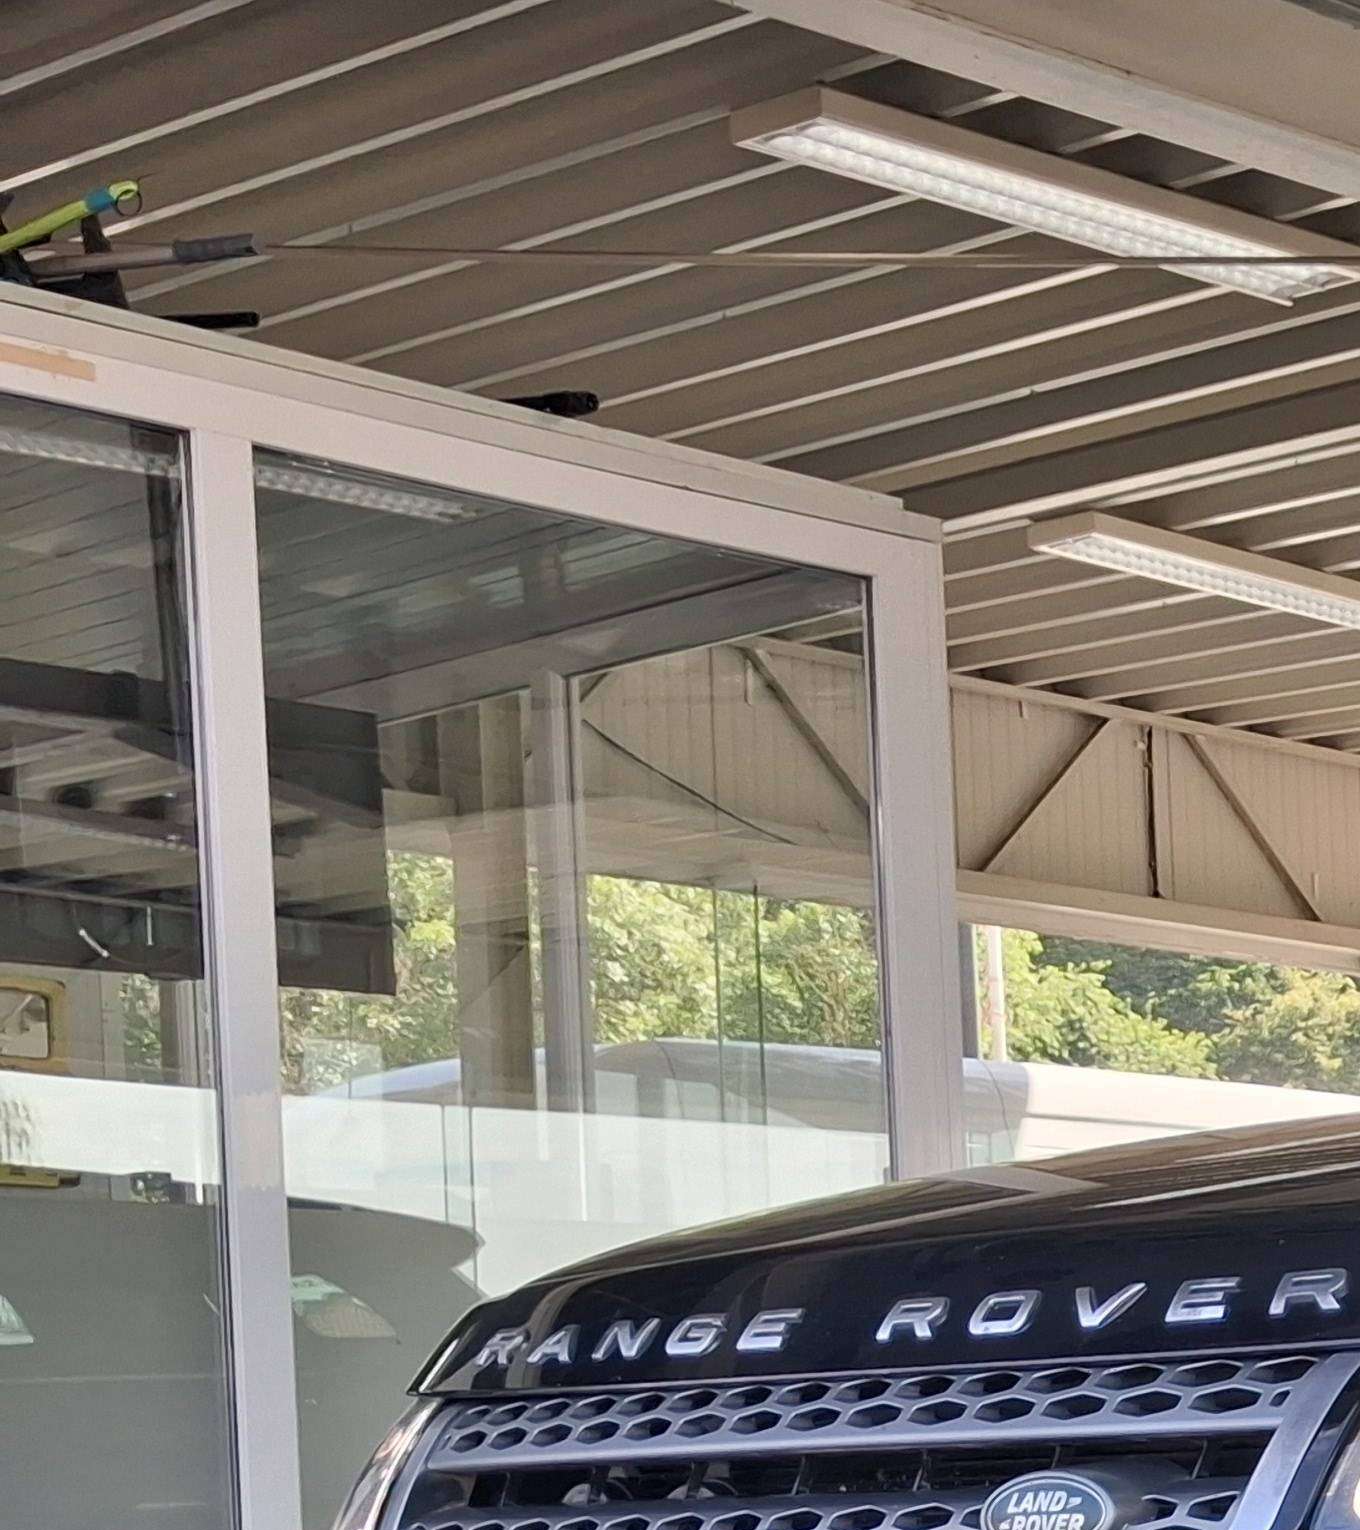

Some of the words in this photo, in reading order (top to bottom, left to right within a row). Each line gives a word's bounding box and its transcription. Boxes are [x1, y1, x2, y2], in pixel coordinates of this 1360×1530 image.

[475, 1307, 805, 1366] RANGE
[874, 1266, 1350, 1344] ROVER
[1007, 1490, 1068, 1514] LAND
